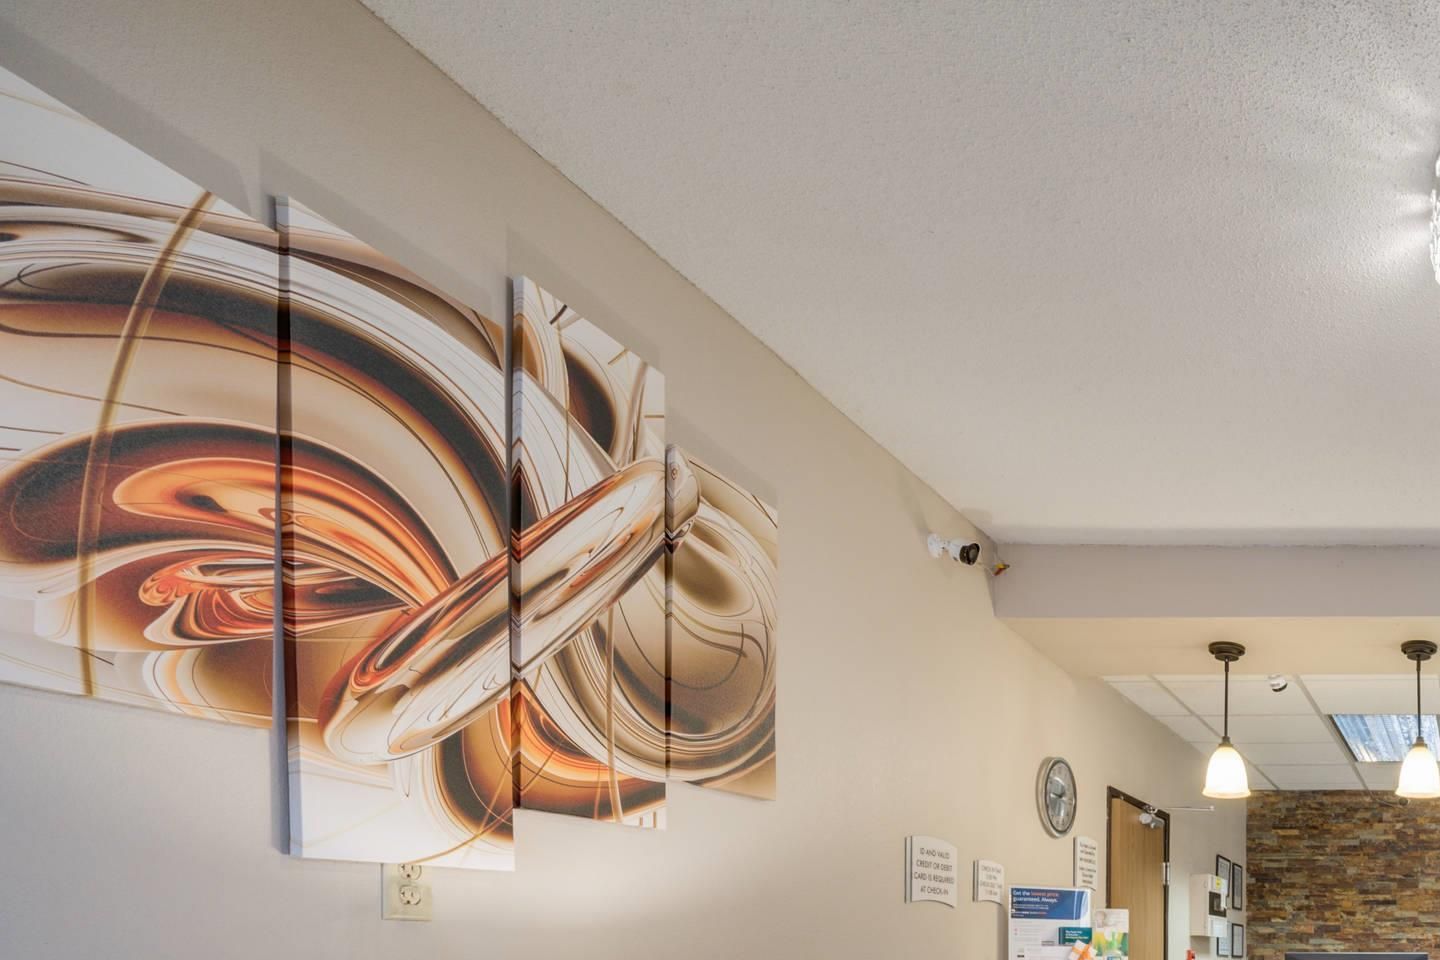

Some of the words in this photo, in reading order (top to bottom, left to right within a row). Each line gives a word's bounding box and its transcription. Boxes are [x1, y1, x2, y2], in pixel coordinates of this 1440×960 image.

[925, 849, 936, 857] AND
[916, 859, 932, 869] CREDIT
[914, 871, 928, 880] CARD
